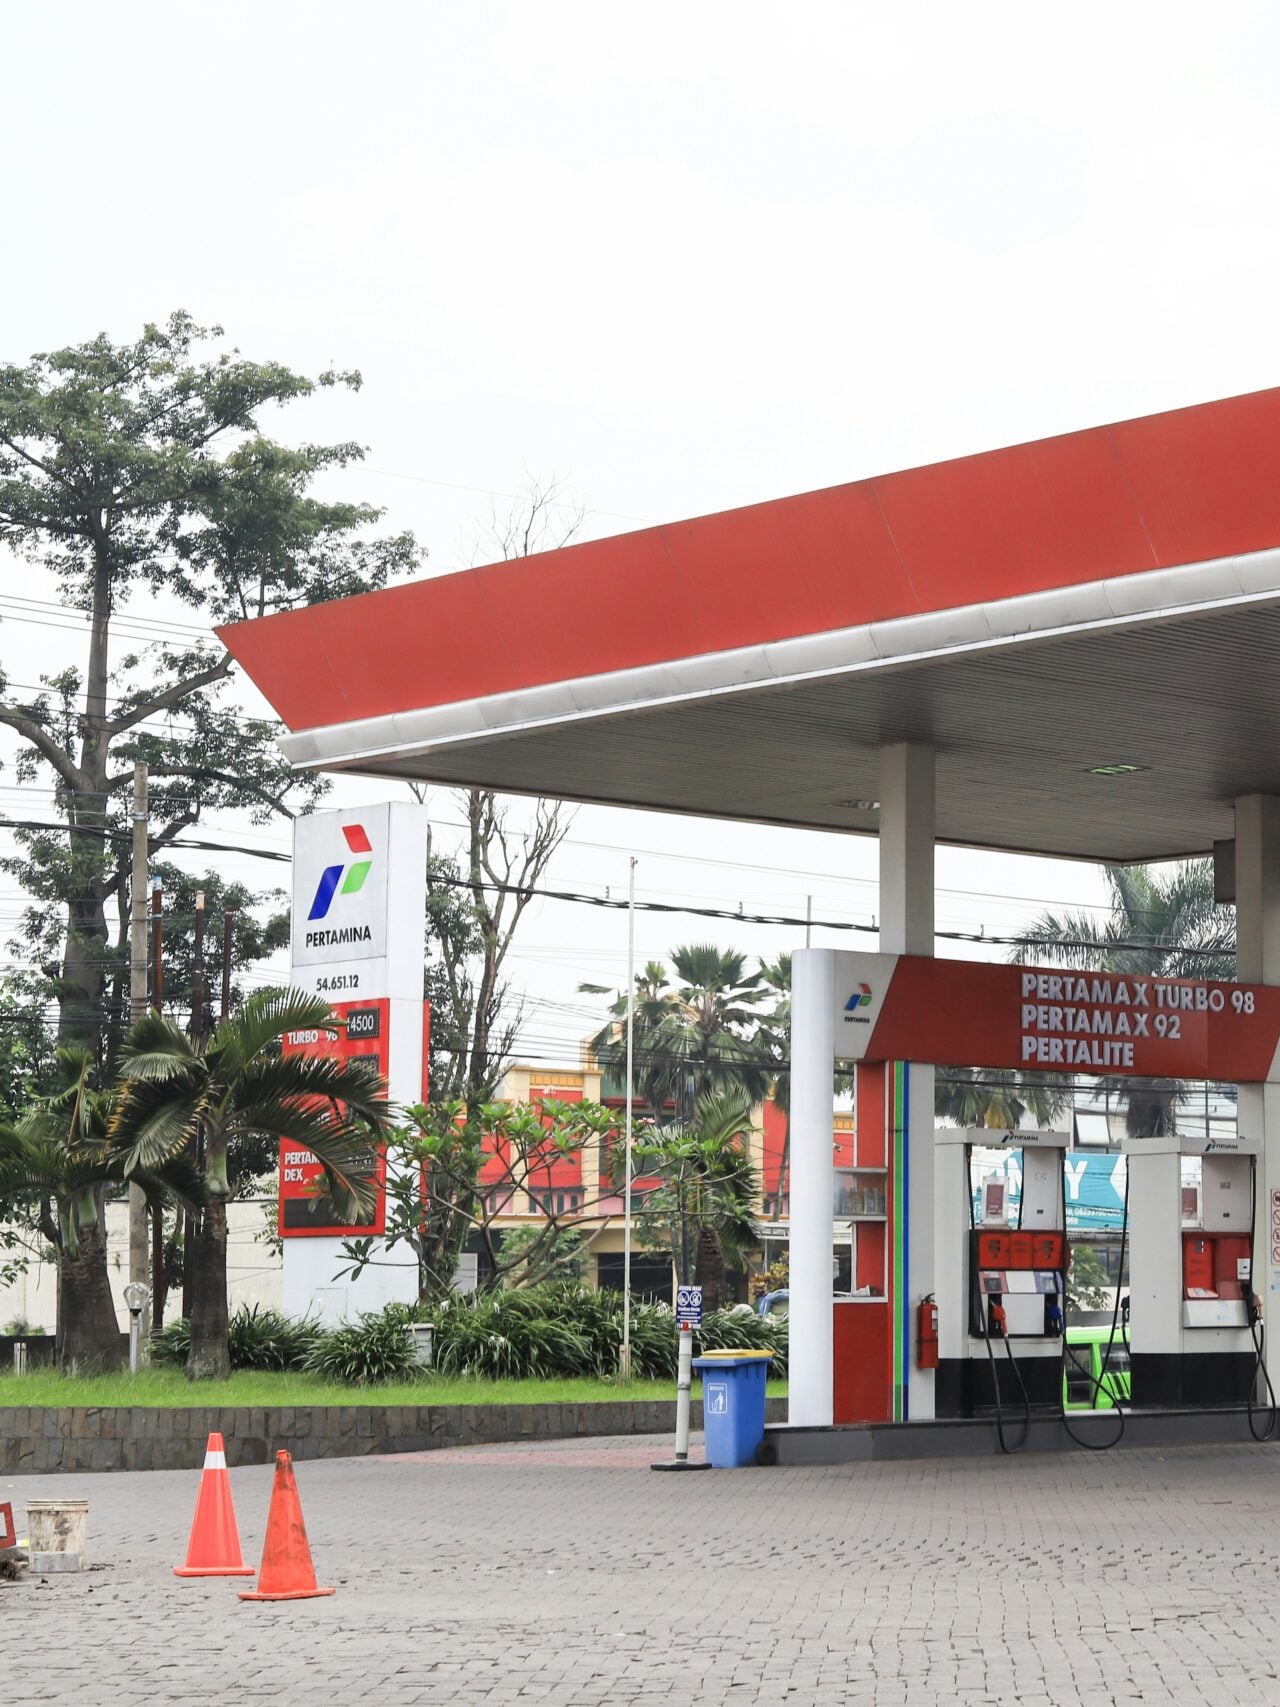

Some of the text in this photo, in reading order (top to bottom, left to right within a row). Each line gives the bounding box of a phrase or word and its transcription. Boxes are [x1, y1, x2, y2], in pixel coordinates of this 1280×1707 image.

[306, 926, 372, 948] PERTAMINA
[316, 974, 359, 991] 54.651.12
[1022, 973, 1255, 1014] PERTAMAX TURBO 98
[1022, 1003, 1181, 1040] PERTAMAX 92
[287, 1030, 319, 1045] TURBO
[1022, 1036, 1134, 1067] PERTALITE
[284, 1152, 321, 1165] PERTAM
[284, 1168, 303, 1182] DEX
